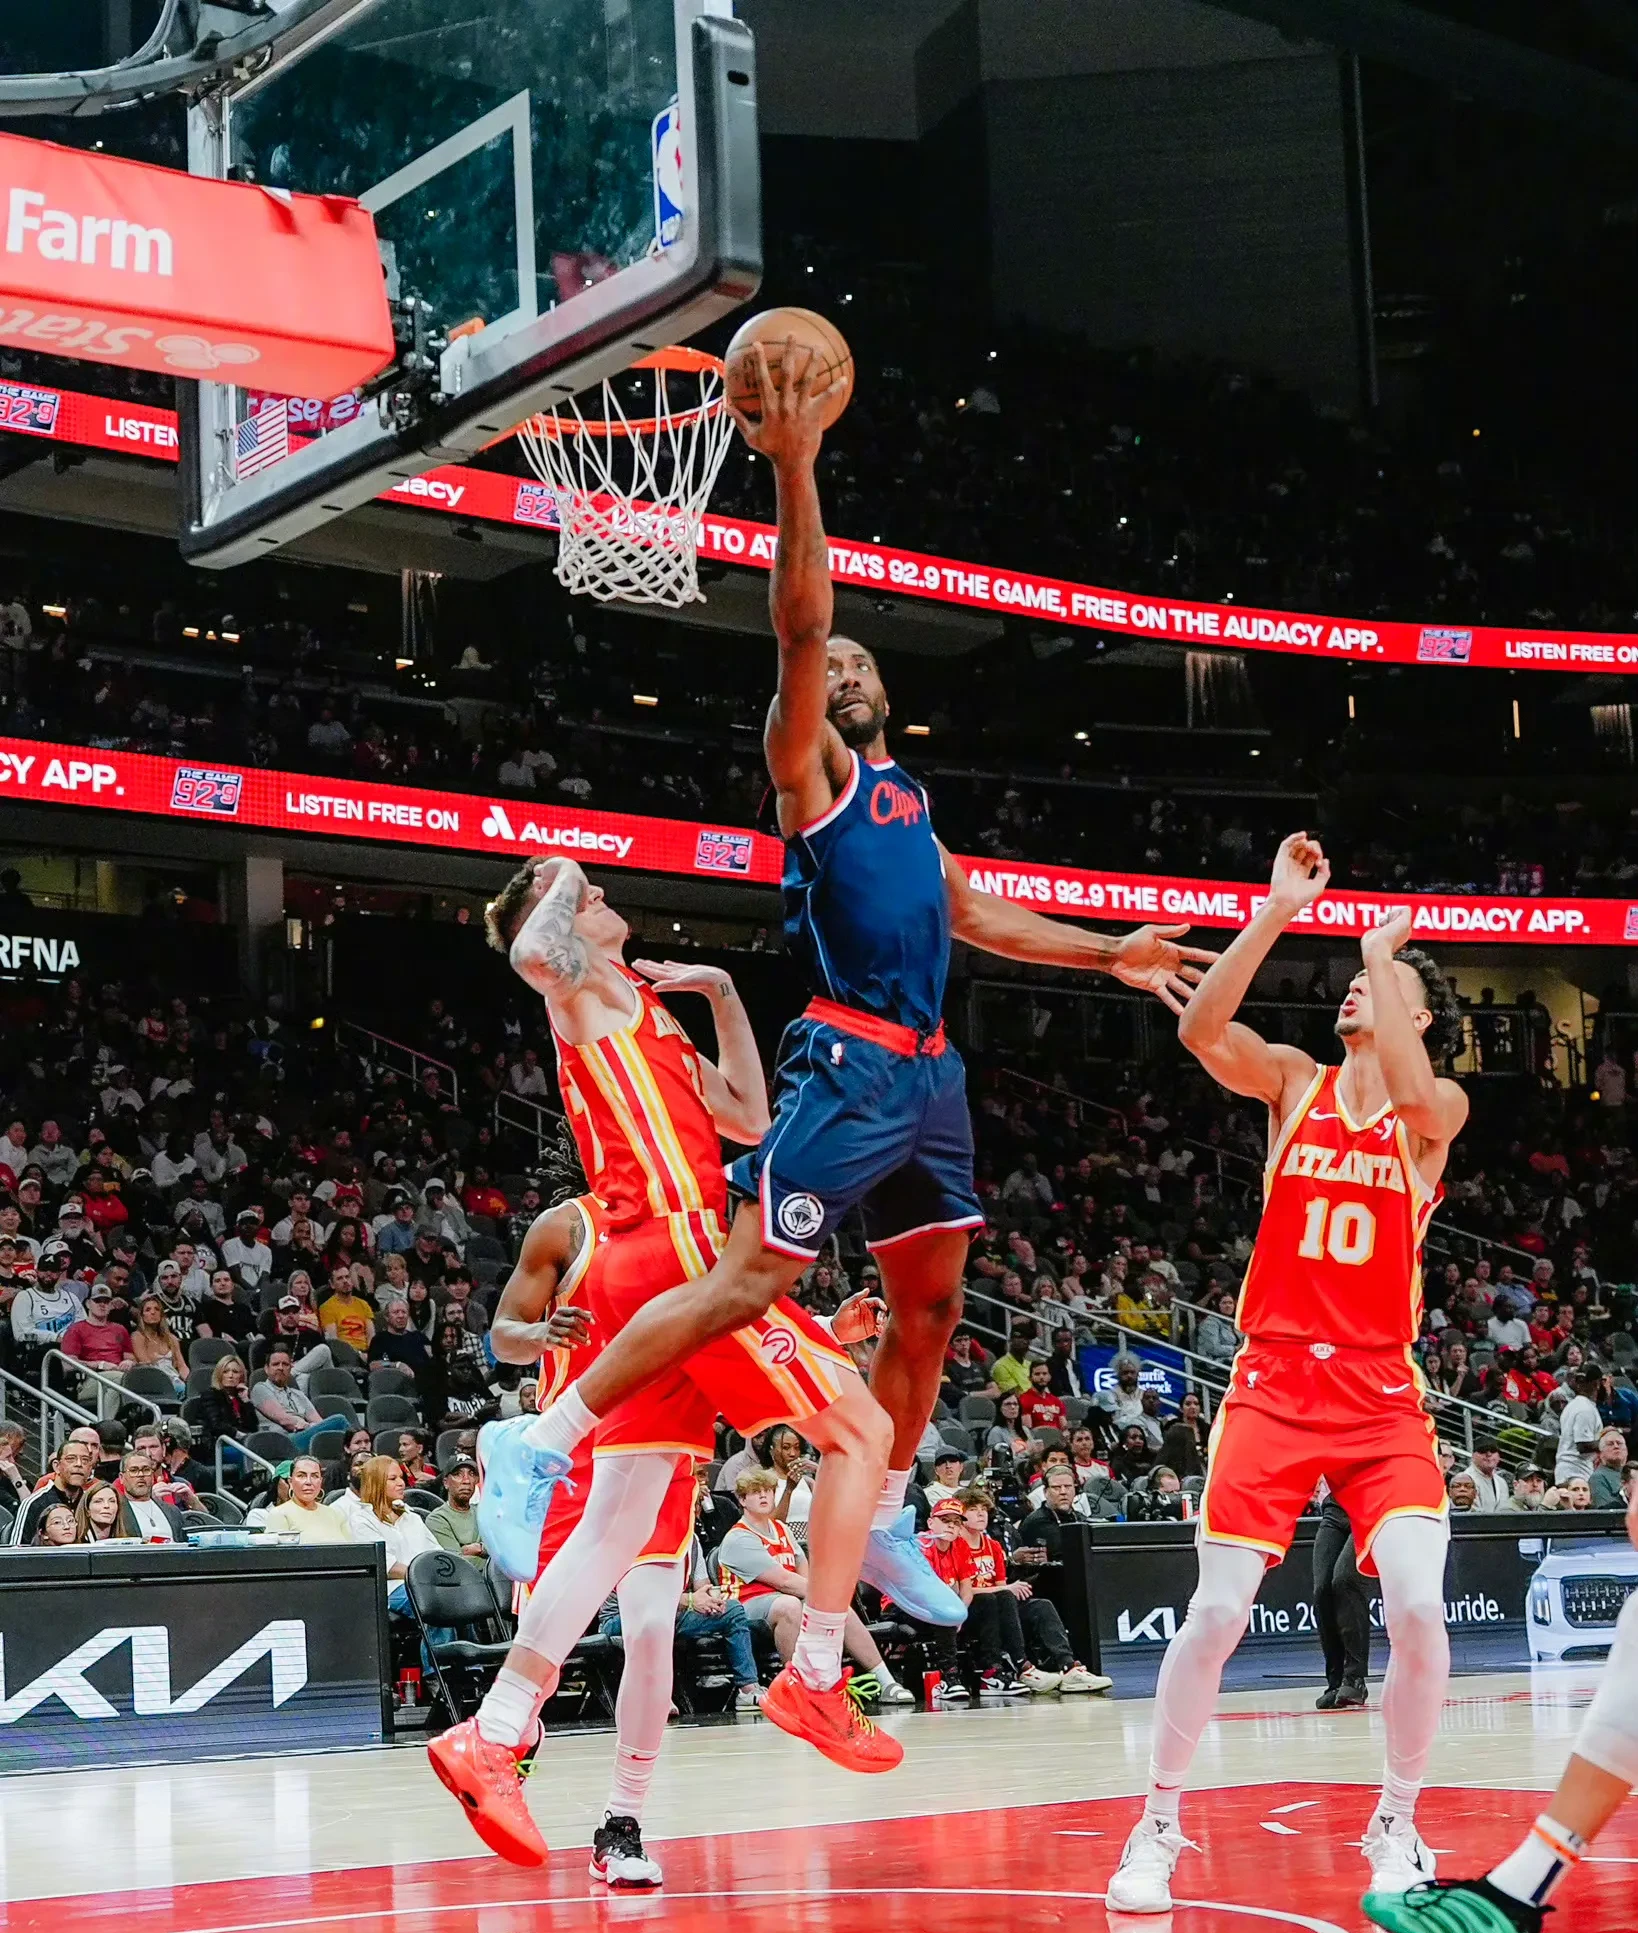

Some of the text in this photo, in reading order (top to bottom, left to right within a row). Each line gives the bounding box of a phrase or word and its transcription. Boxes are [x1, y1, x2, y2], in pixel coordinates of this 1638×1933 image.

[6, 188, 173, 277] Farm
[0, 309, 154, 355] Stat
[707, 525, 745, 554] TO
[889, 560, 940, 590] 92.9
[942, 568, 989, 600] THE
[993, 579, 1067, 617] GAME,
[1072, 594, 1127, 625] FREE
[1131, 604, 1167, 630] ON
[1169, 609, 1219, 636] THE
[1224, 616, 1323, 646] AUDACY
[1327, 627, 1384, 653] APP.
[1506, 641, 1567, 660] LISTEN
[1570, 644, 1614, 662] FREE
[42, 760, 124, 795] APP.
[180, 769, 239, 784] THE GAME
[287, 792, 458, 831] LISTEN FREE ON
[520, 822, 633, 858] Audacy
[1055, 880, 1105, 907] 92.9
[1107, 885, 1158, 911] THE
[1163, 889, 1245, 922] GAME,
[1317, 900, 1354, 925] ON
[1414, 906, 1522, 932] AUDACY
[1528, 910, 1590, 934] APP.
[1281, 1143, 1406, 1195] ATLANTA
[1297, 1196, 1377, 1266] 10
[1250, 1602, 1289, 1633] The
